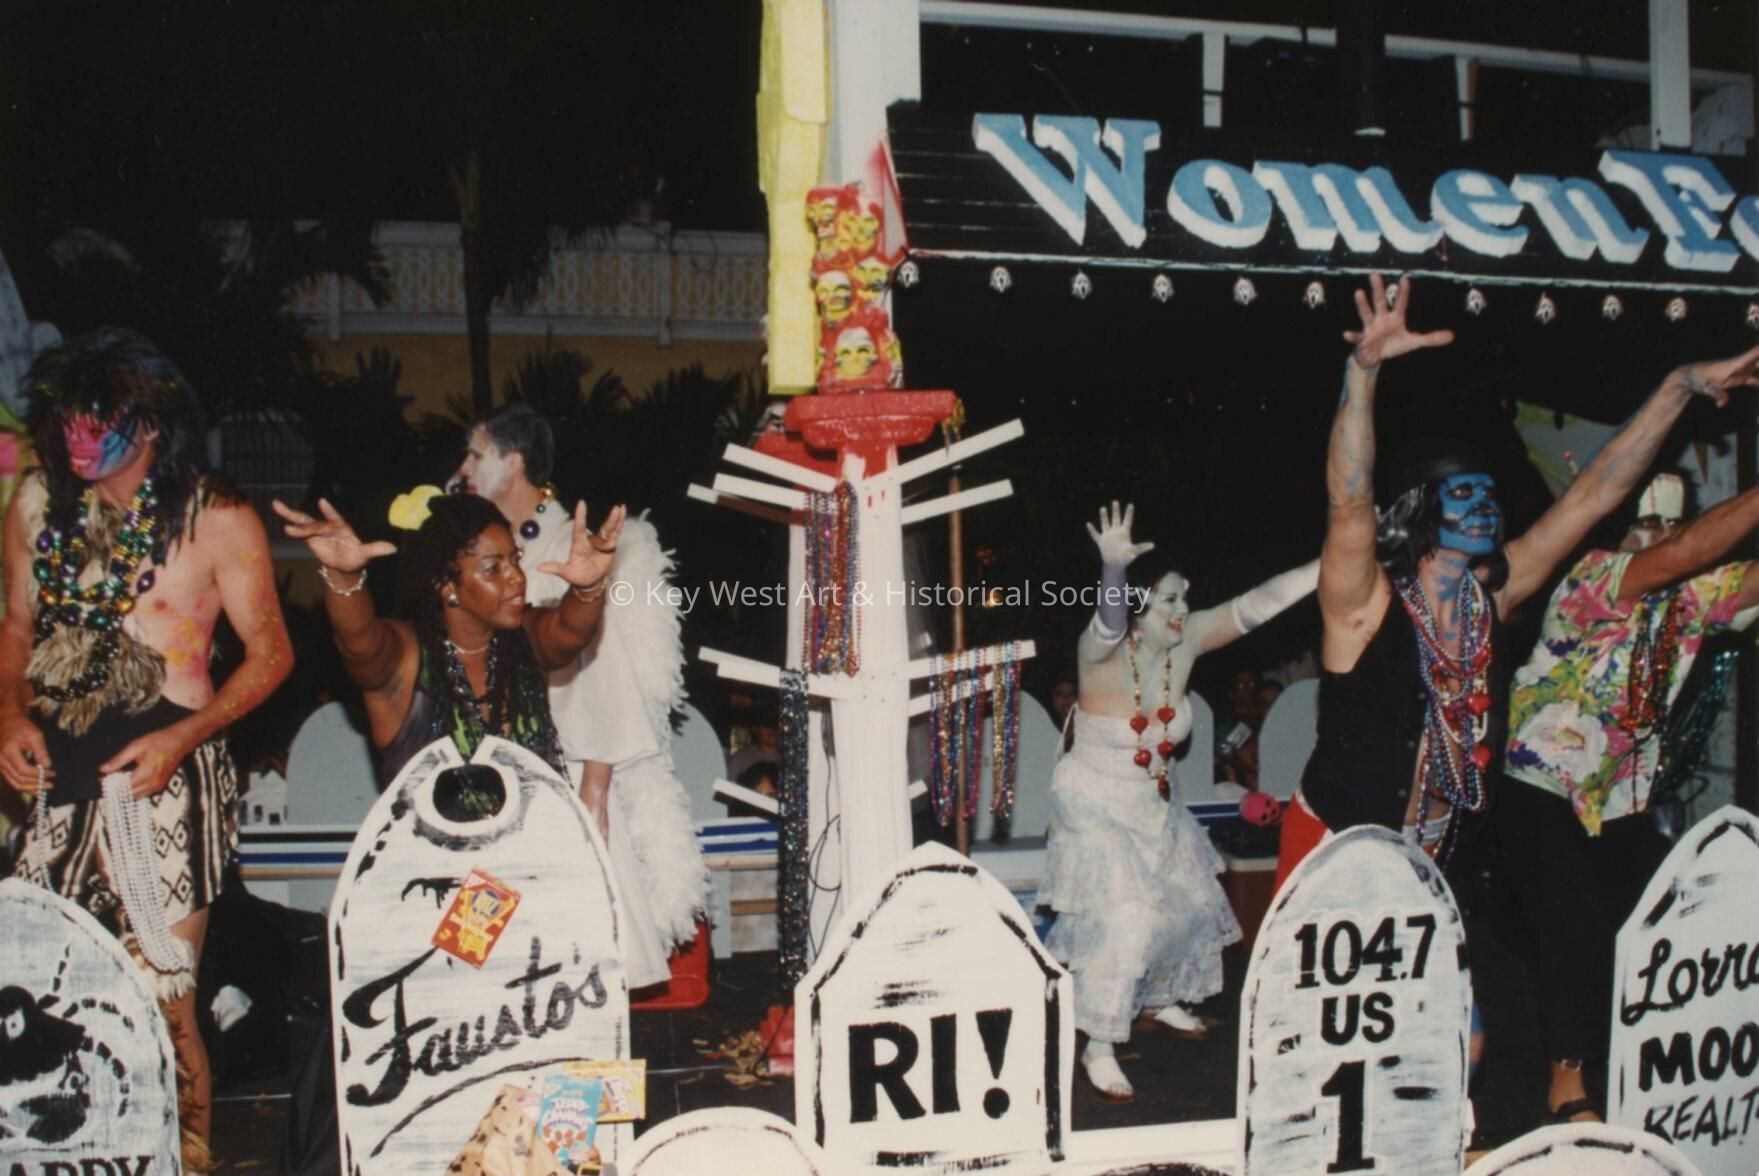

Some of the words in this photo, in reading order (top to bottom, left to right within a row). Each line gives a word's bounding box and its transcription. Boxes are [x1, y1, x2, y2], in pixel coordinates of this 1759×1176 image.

[1294, 913, 1437, 989] 104.7
[848, 1007, 1013, 1123] RI!
[1320, 991, 1395, 1046] US
[1320, 1059, 1375, 1174] 1
